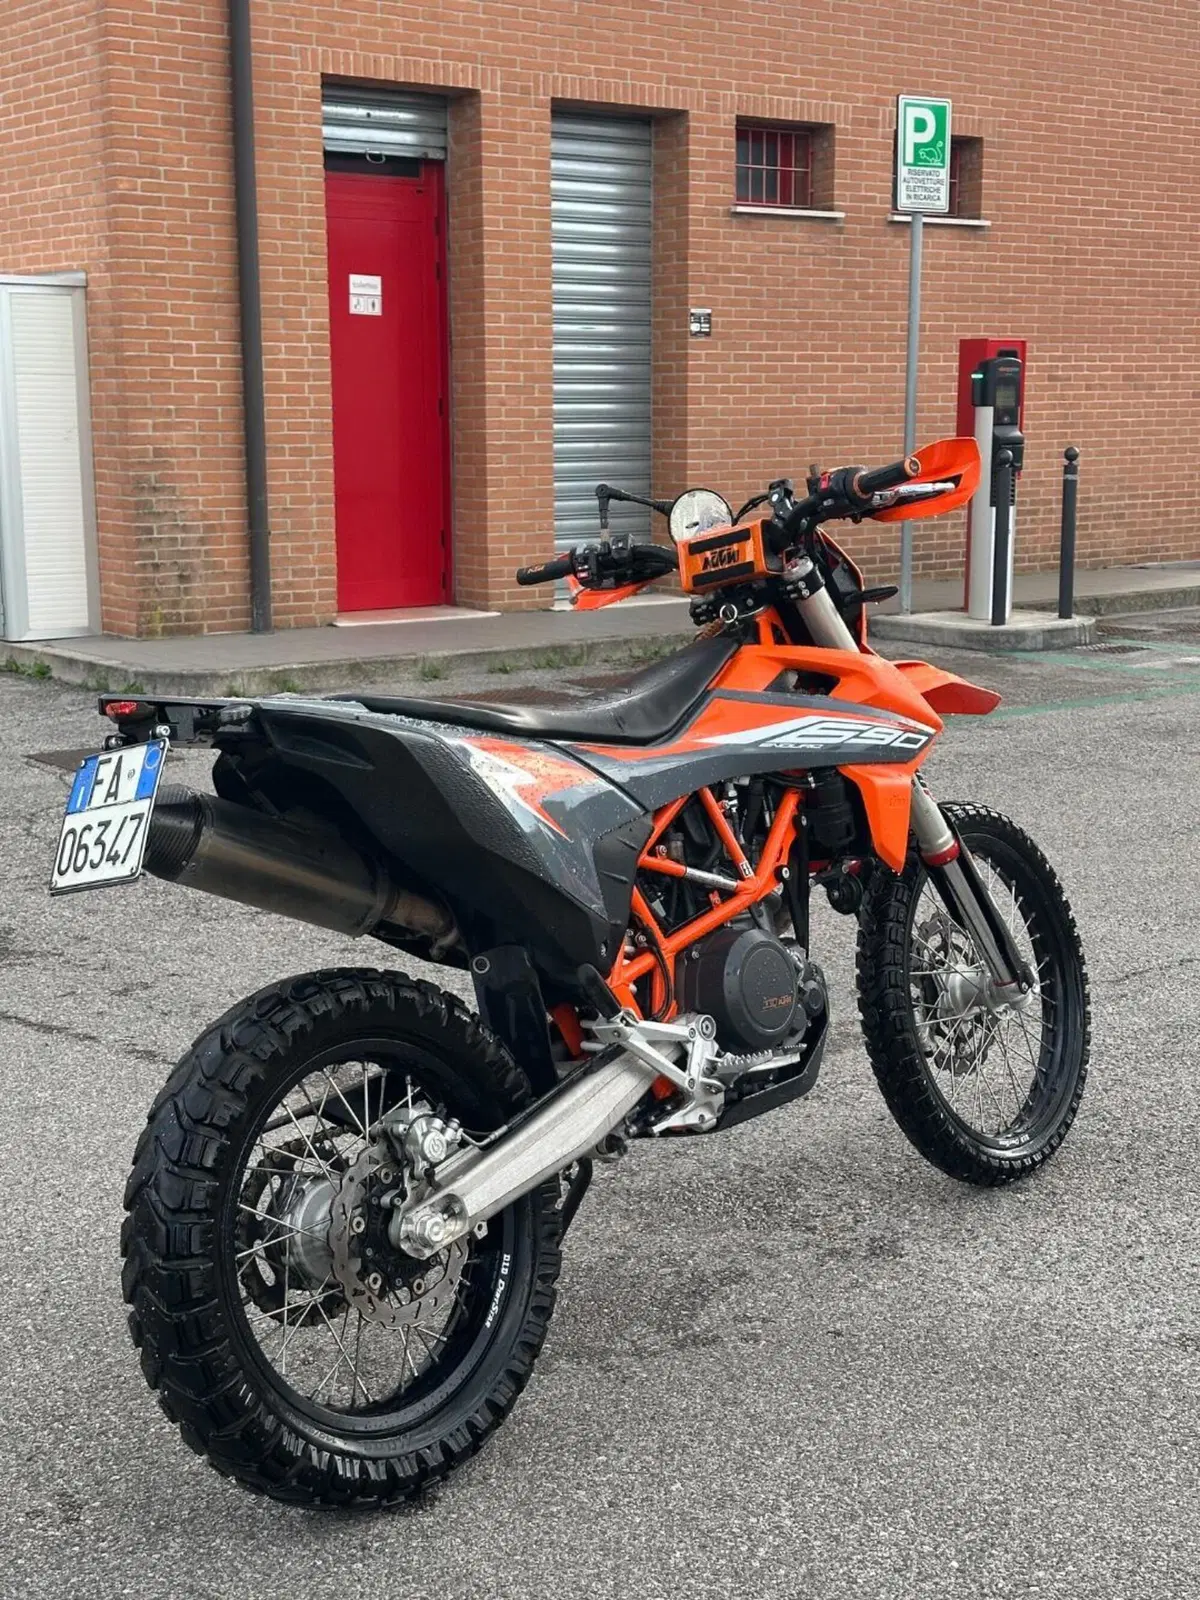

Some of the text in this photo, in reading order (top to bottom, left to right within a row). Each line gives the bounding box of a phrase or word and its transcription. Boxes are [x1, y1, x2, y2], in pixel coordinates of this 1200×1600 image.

[905, 106, 936, 164] P
[903, 177, 944, 186] AUTOVETTURE
[908, 168, 940, 177] RISERVATO
[906, 185, 941, 193] ELETTRICHE
[769, 720, 929, 750] 690
[88, 755, 123, 806] FA
[57, 812, 145, 876] 06347
